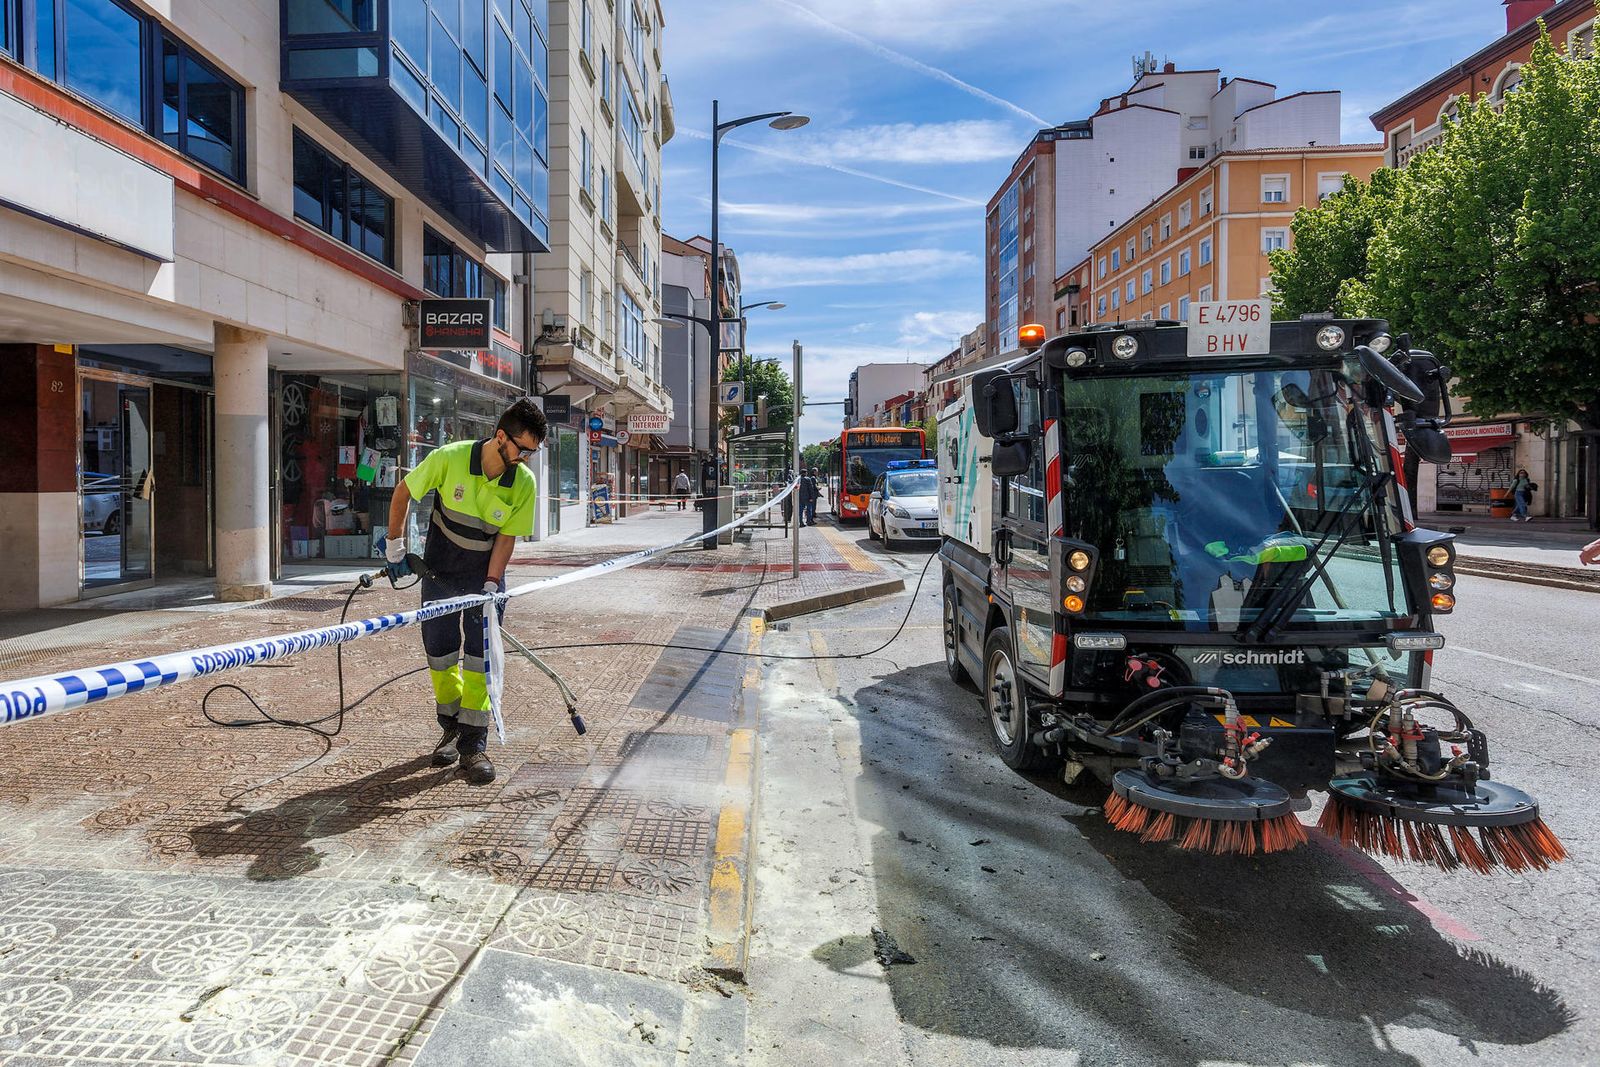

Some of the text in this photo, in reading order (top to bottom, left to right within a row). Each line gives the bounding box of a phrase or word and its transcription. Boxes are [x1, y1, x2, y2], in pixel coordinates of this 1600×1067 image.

[426, 313, 483, 325] BAZAR
[1199, 304, 1261, 324] E 4796
[51, 380, 64, 392] 82
[256, 641, 276, 661] DE
[276, 633, 318, 656] LOCAL
[191, 645, 256, 678] BURGOS
[1223, 650, 1305, 664] schmidt
[0, 687, 47, 724] POL
